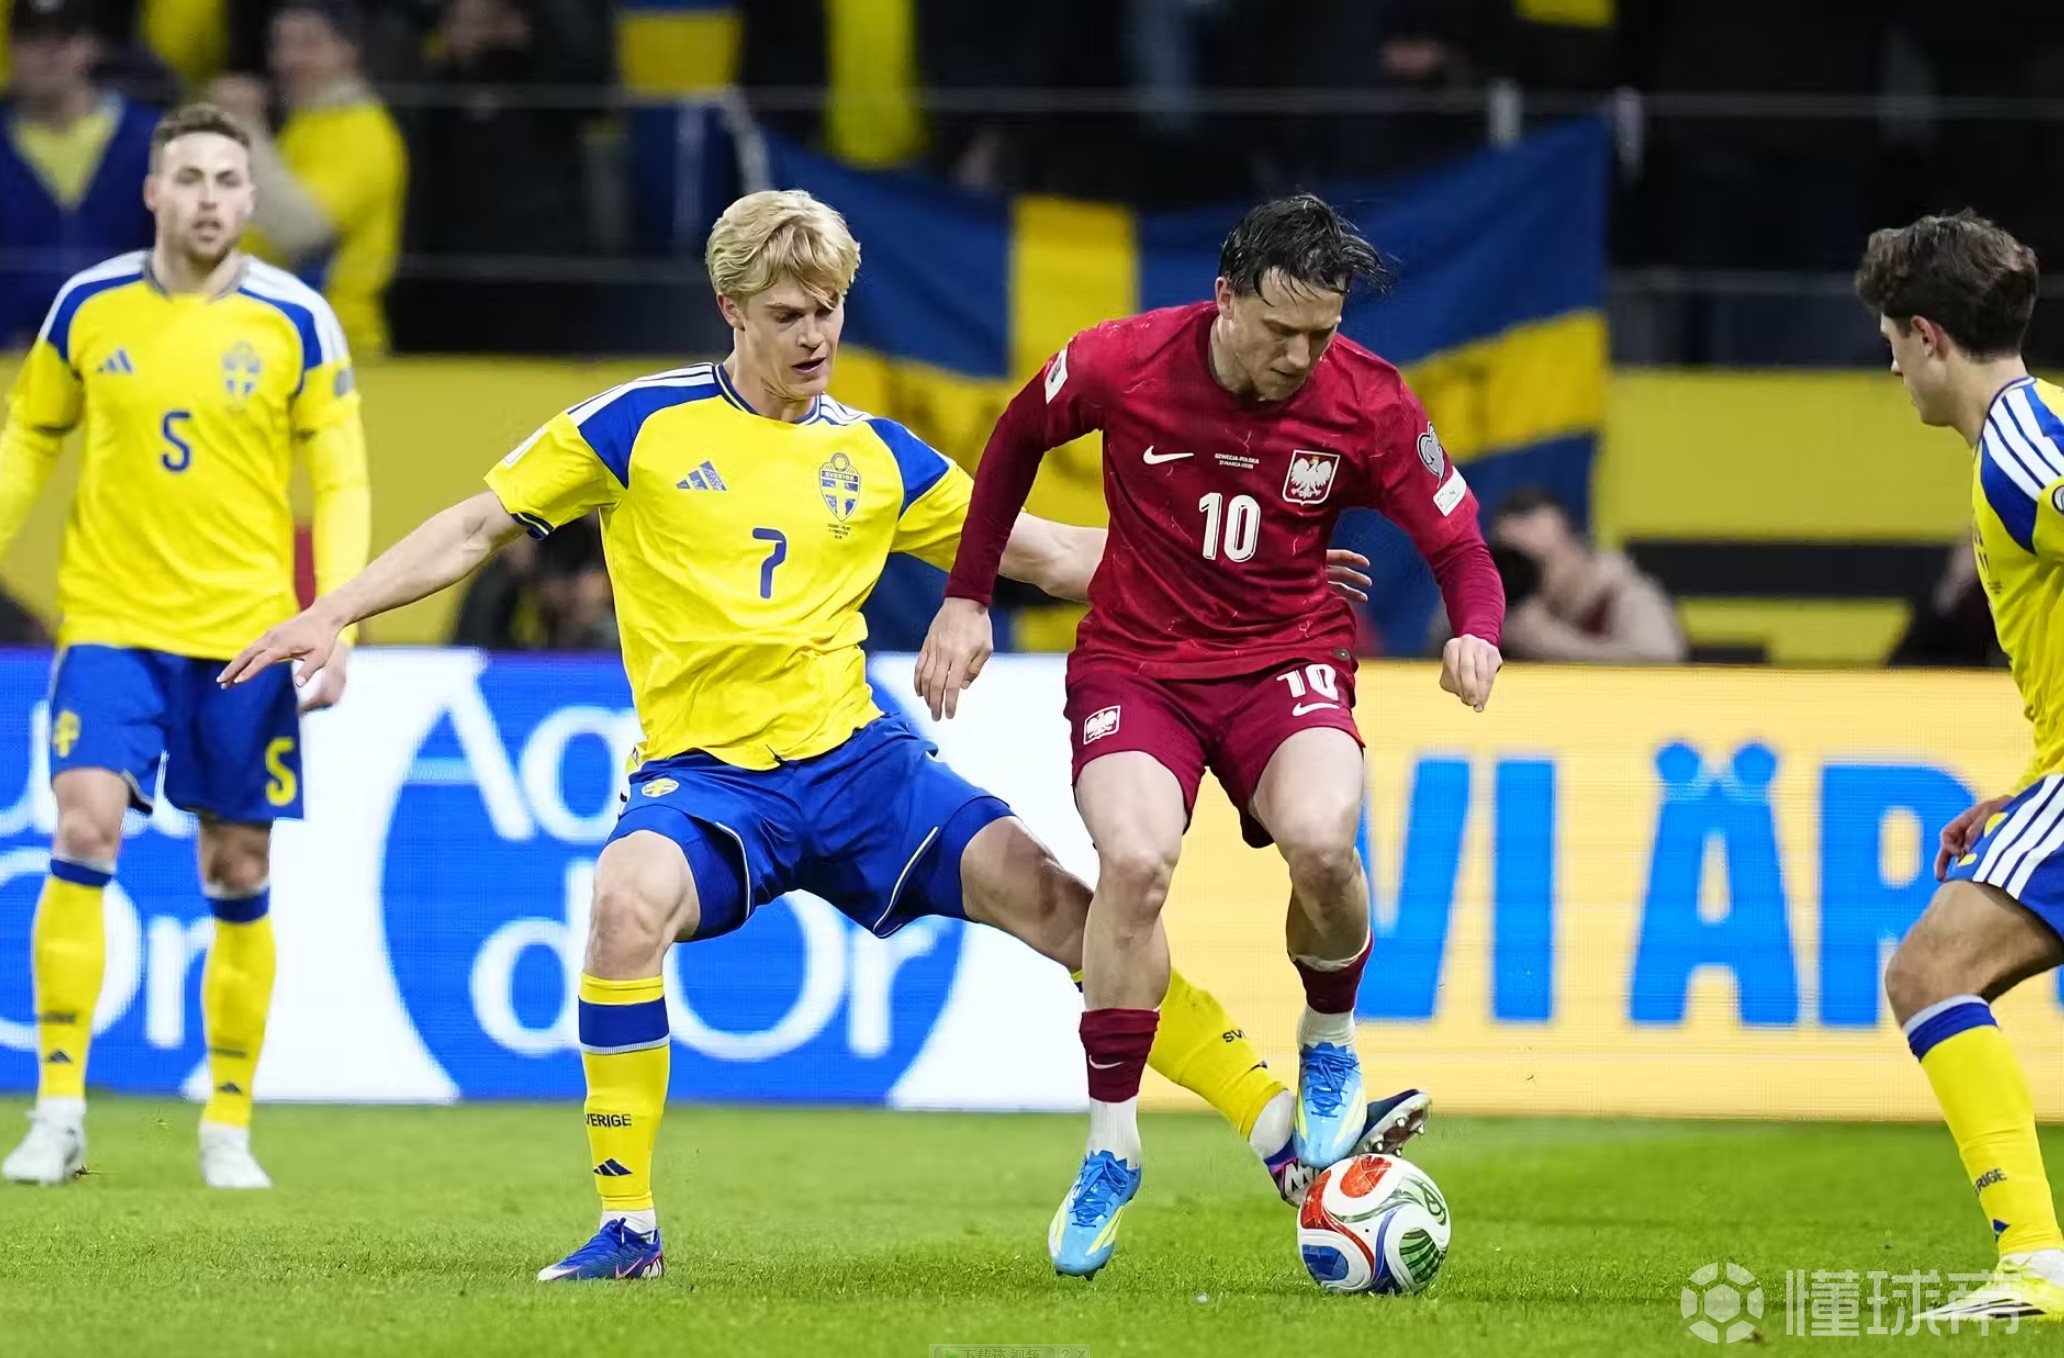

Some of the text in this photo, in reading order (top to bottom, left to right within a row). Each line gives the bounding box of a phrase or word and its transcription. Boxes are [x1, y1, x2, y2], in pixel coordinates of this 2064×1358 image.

[163, 411, 191, 472] 5
[1199, 492, 1261, 563] 10
[752, 528, 787, 599] 7
[1277, 664, 1338, 700] 10
[1356, 741, 1985, 1028] VI ÄR
[1222, 1029, 1247, 1043] SV
